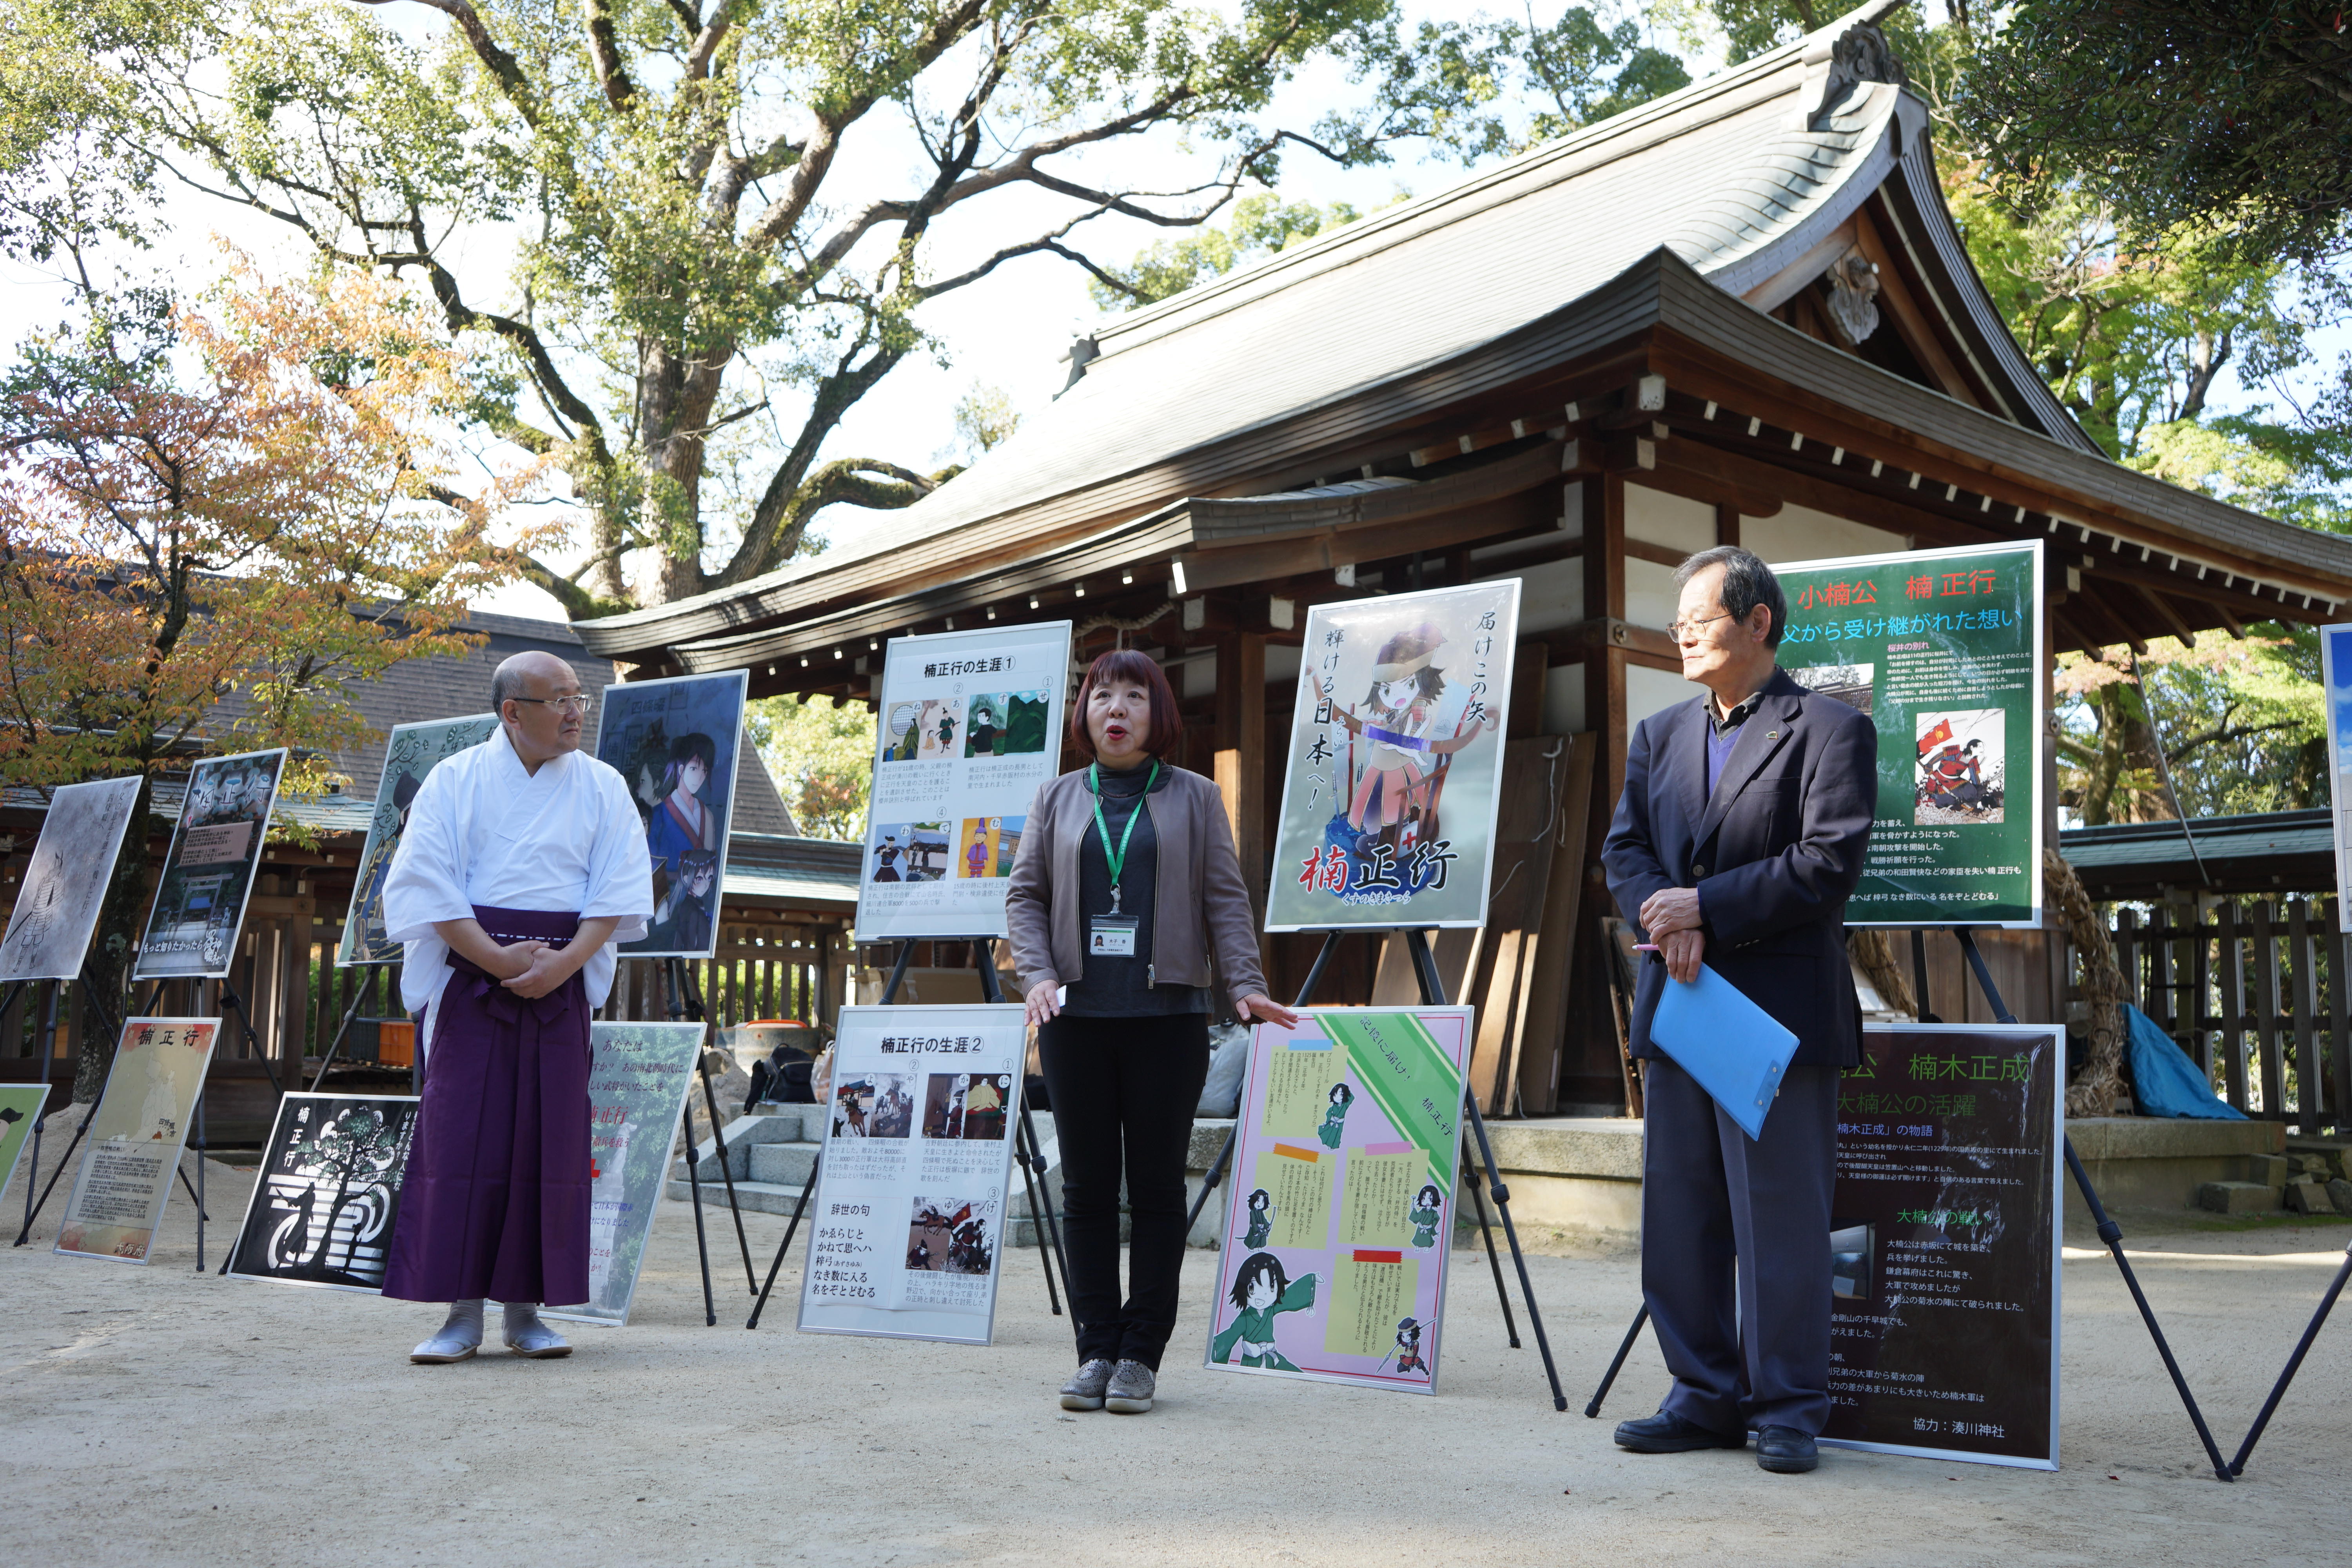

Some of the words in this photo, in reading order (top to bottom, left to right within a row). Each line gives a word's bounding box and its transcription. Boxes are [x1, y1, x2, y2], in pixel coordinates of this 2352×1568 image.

[1797, 580, 1877, 610] 小楠公
[1905, 574, 1933, 600] 楠
[1940, 570, 1996, 596] 正行
[1780, 609, 2022, 645] 父から受け継がれた想い
[1887, 641, 1929, 652] 桜井の別れ
[925, 655, 1016, 678] 楠正行の生涯①
[1465, 612, 1495, 722] 届けこの矢
[1000, 694, 1008, 703] す
[1305, 629, 1344, 810] 輝ける日本へ！
[1334, 715, 1346, 748] みらい
[967, 781, 1013, 789] 里で生まれました
[993, 819, 1000, 828] む
[1869, 830, 1960, 840] 軍を脅かすようになった。
[1299, 840, 1458, 892] 楠正行
[1342, 891, 1411, 905] くすのきまさつら
[1890, 892, 1937, 901] なき数にいる
[144, 940, 203, 953] もっと知りたかったら
[138, 1029, 199, 1047] 楠正行
[881, 1036, 984, 1053] 楠正行の生涯②
[603, 1039, 643, 1052] あなたは
[622, 1063, 683, 1073] あの南北朝時代に
[1841, 1053, 1877, 1079] 公
[1909, 1053, 2031, 1082] 楠木正成
[867, 1075, 873, 1083] よ
[1000, 1077, 1008, 1085] に
[1360, 1016, 1410, 1082] 記憶に届け！
[1422, 1098, 1453, 1135] 楠正行
[588, 1081, 663, 1091] しい武将がいたことを
[1837, 1092, 1976, 1116] 大楠公の活躍
[284, 1106, 310, 1167] 楠正行
[591, 1137, 629, 1147] 敵兵を救う
[1837, 1142, 2042, 1155] 丸」という幼名を授かり永仁二年(1229年)の国赤坂の里にて生まれました。
[1837, 1152, 1886, 1160] 天皇に呼び出され
[592, 1201, 633, 1211] て日本が国際赤
[831, 1203, 869, 1216] 辞世の句
[944, 1201, 953, 1210] ゆ
[987, 1203, 995, 1212] け
[1897, 1208, 1990, 1226] 大楠公の戦い
[114, 1242, 145, 1257] 大阪府
[1887, 1240, 1991, 1253] 大楠公は赤坂にて城を築き、
[1887, 1253, 1948, 1265] 兵を挙げました。
[813, 1269, 867, 1282] なき数に入る
[1886, 1266, 1973, 1280] 鎌倉幕府はこれに驚き、
[812, 1283, 875, 1297] 名をぞとどむる
[1885, 1281, 1960, 1293] 大軍で攻めましたが
[1828, 1367, 1925, 1383] 兄弟の大軍から菊水の陣
[1913, 1417, 2005, 1438] 協力：湊川神社
